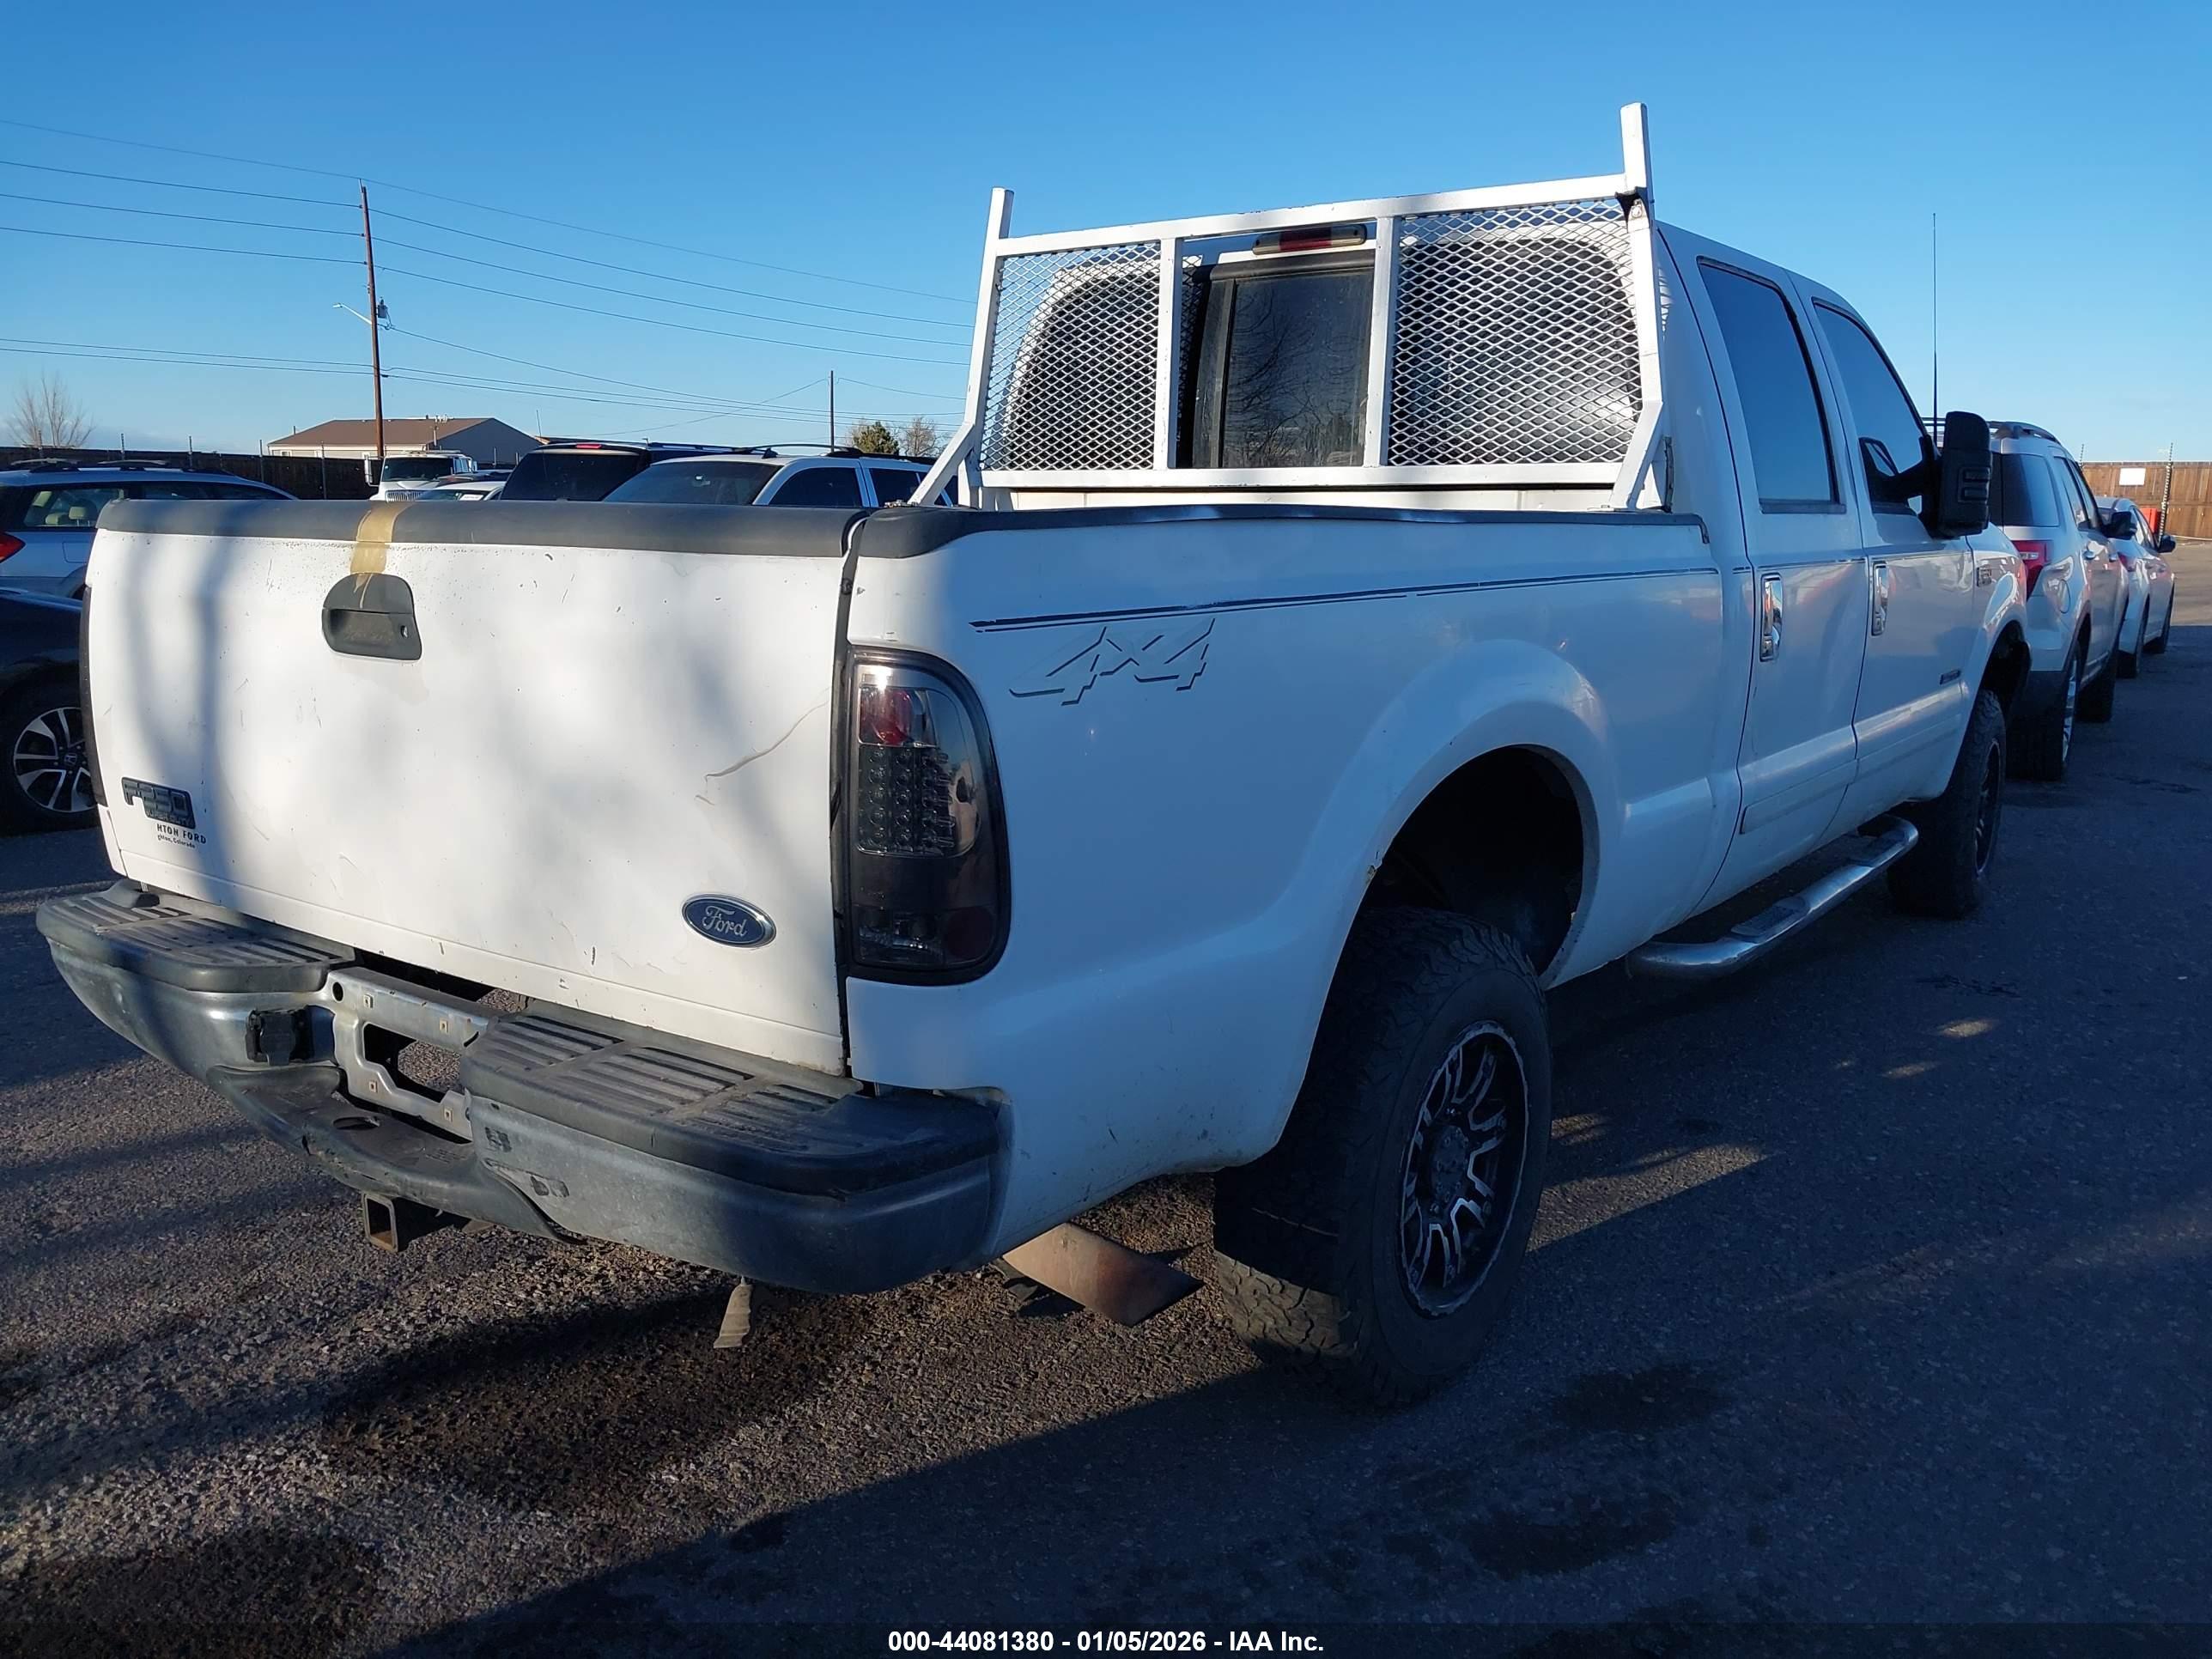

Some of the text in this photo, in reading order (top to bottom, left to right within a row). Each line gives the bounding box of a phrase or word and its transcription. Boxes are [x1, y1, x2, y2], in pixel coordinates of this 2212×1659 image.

[173, 836, 197, 849] Colorado
[182, 830, 207, 845] FORD
[702, 905, 748, 937] Ford
